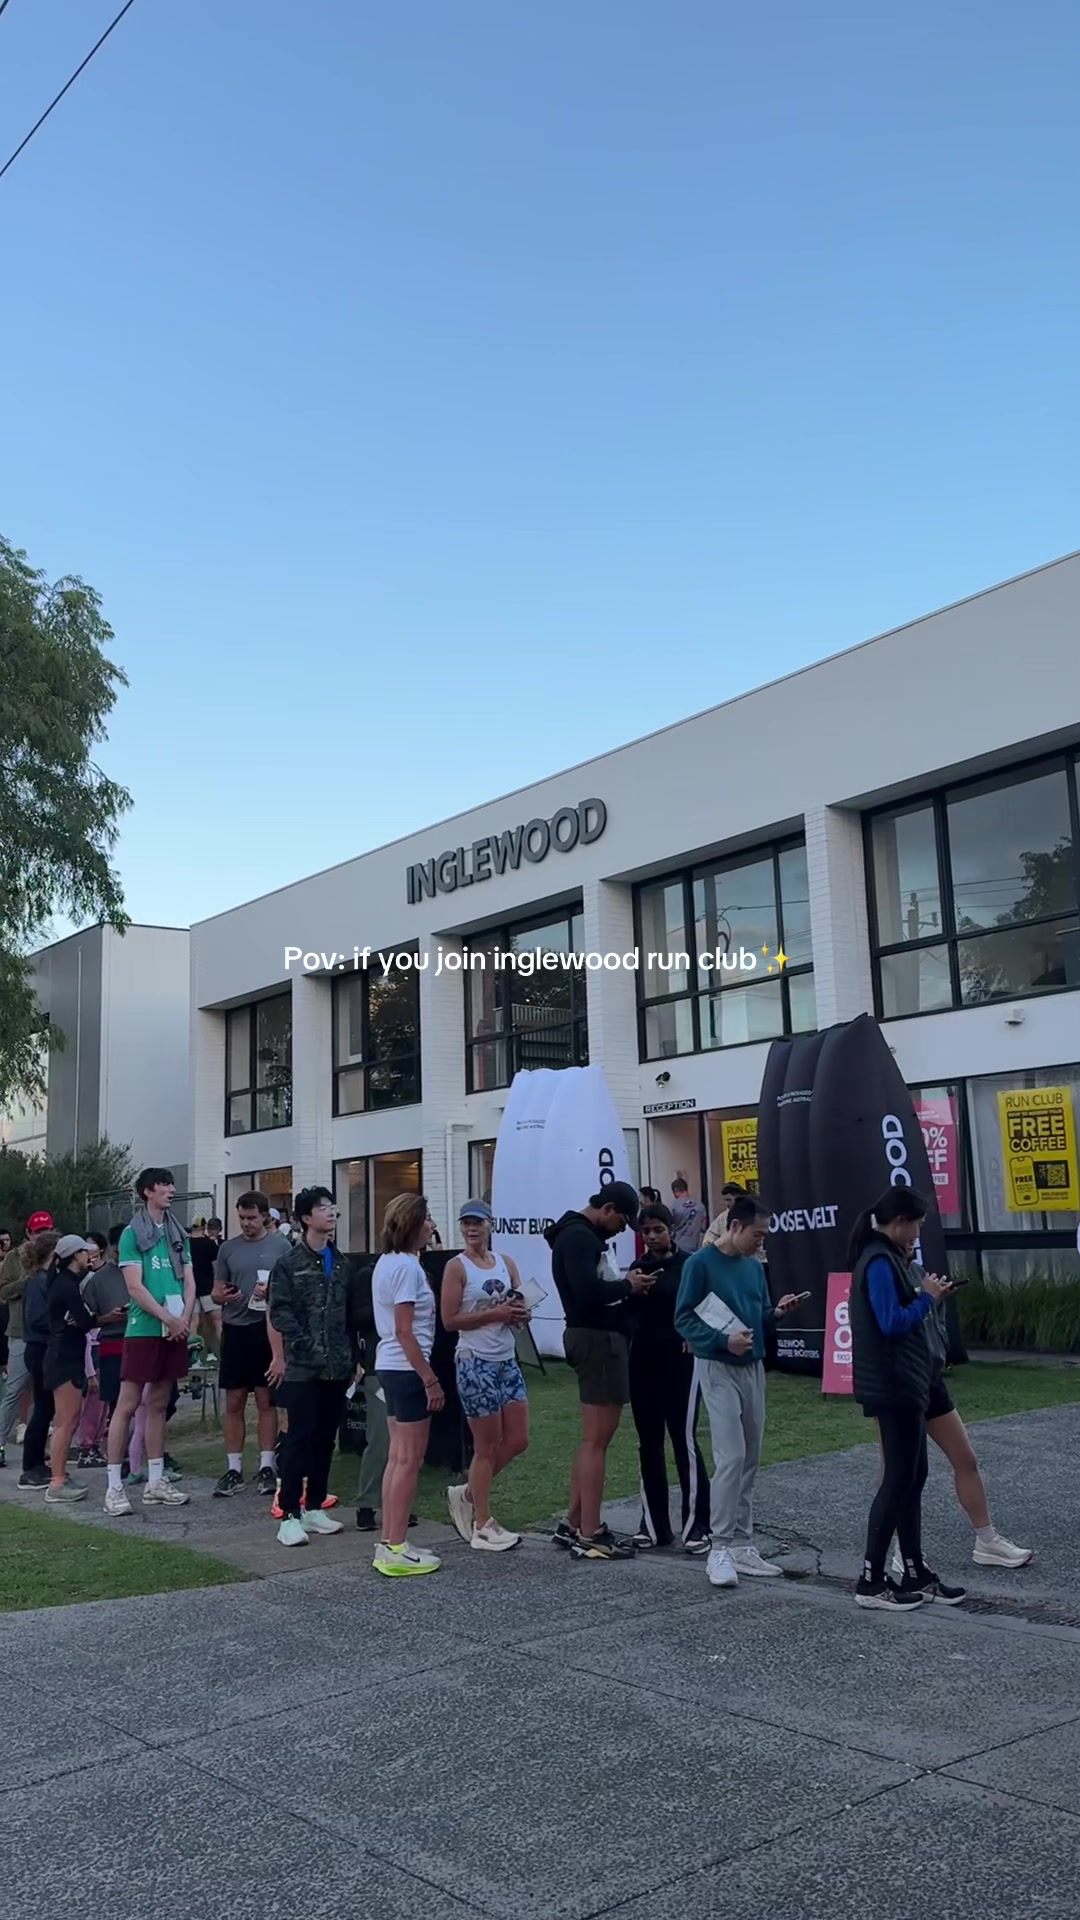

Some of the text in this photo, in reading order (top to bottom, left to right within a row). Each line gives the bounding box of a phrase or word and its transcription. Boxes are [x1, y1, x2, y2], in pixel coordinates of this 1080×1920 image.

[406, 797, 607, 904] INGLEWOOD
[645, 1099, 695, 1113] RECEPTION
[1005, 1093, 1063, 1108] RUN CLUB
[726, 1124, 758, 1135] RUN CL
[1008, 1115, 1065, 1138] FREE
[729, 1141, 757, 1160] FRE
[1010, 1136, 1066, 1152] COFFEE
[730, 1159, 758, 1171] COFF
[1015, 1175, 1033, 1184] FREE
[768, 1205, 839, 1233] OOSEVELT
